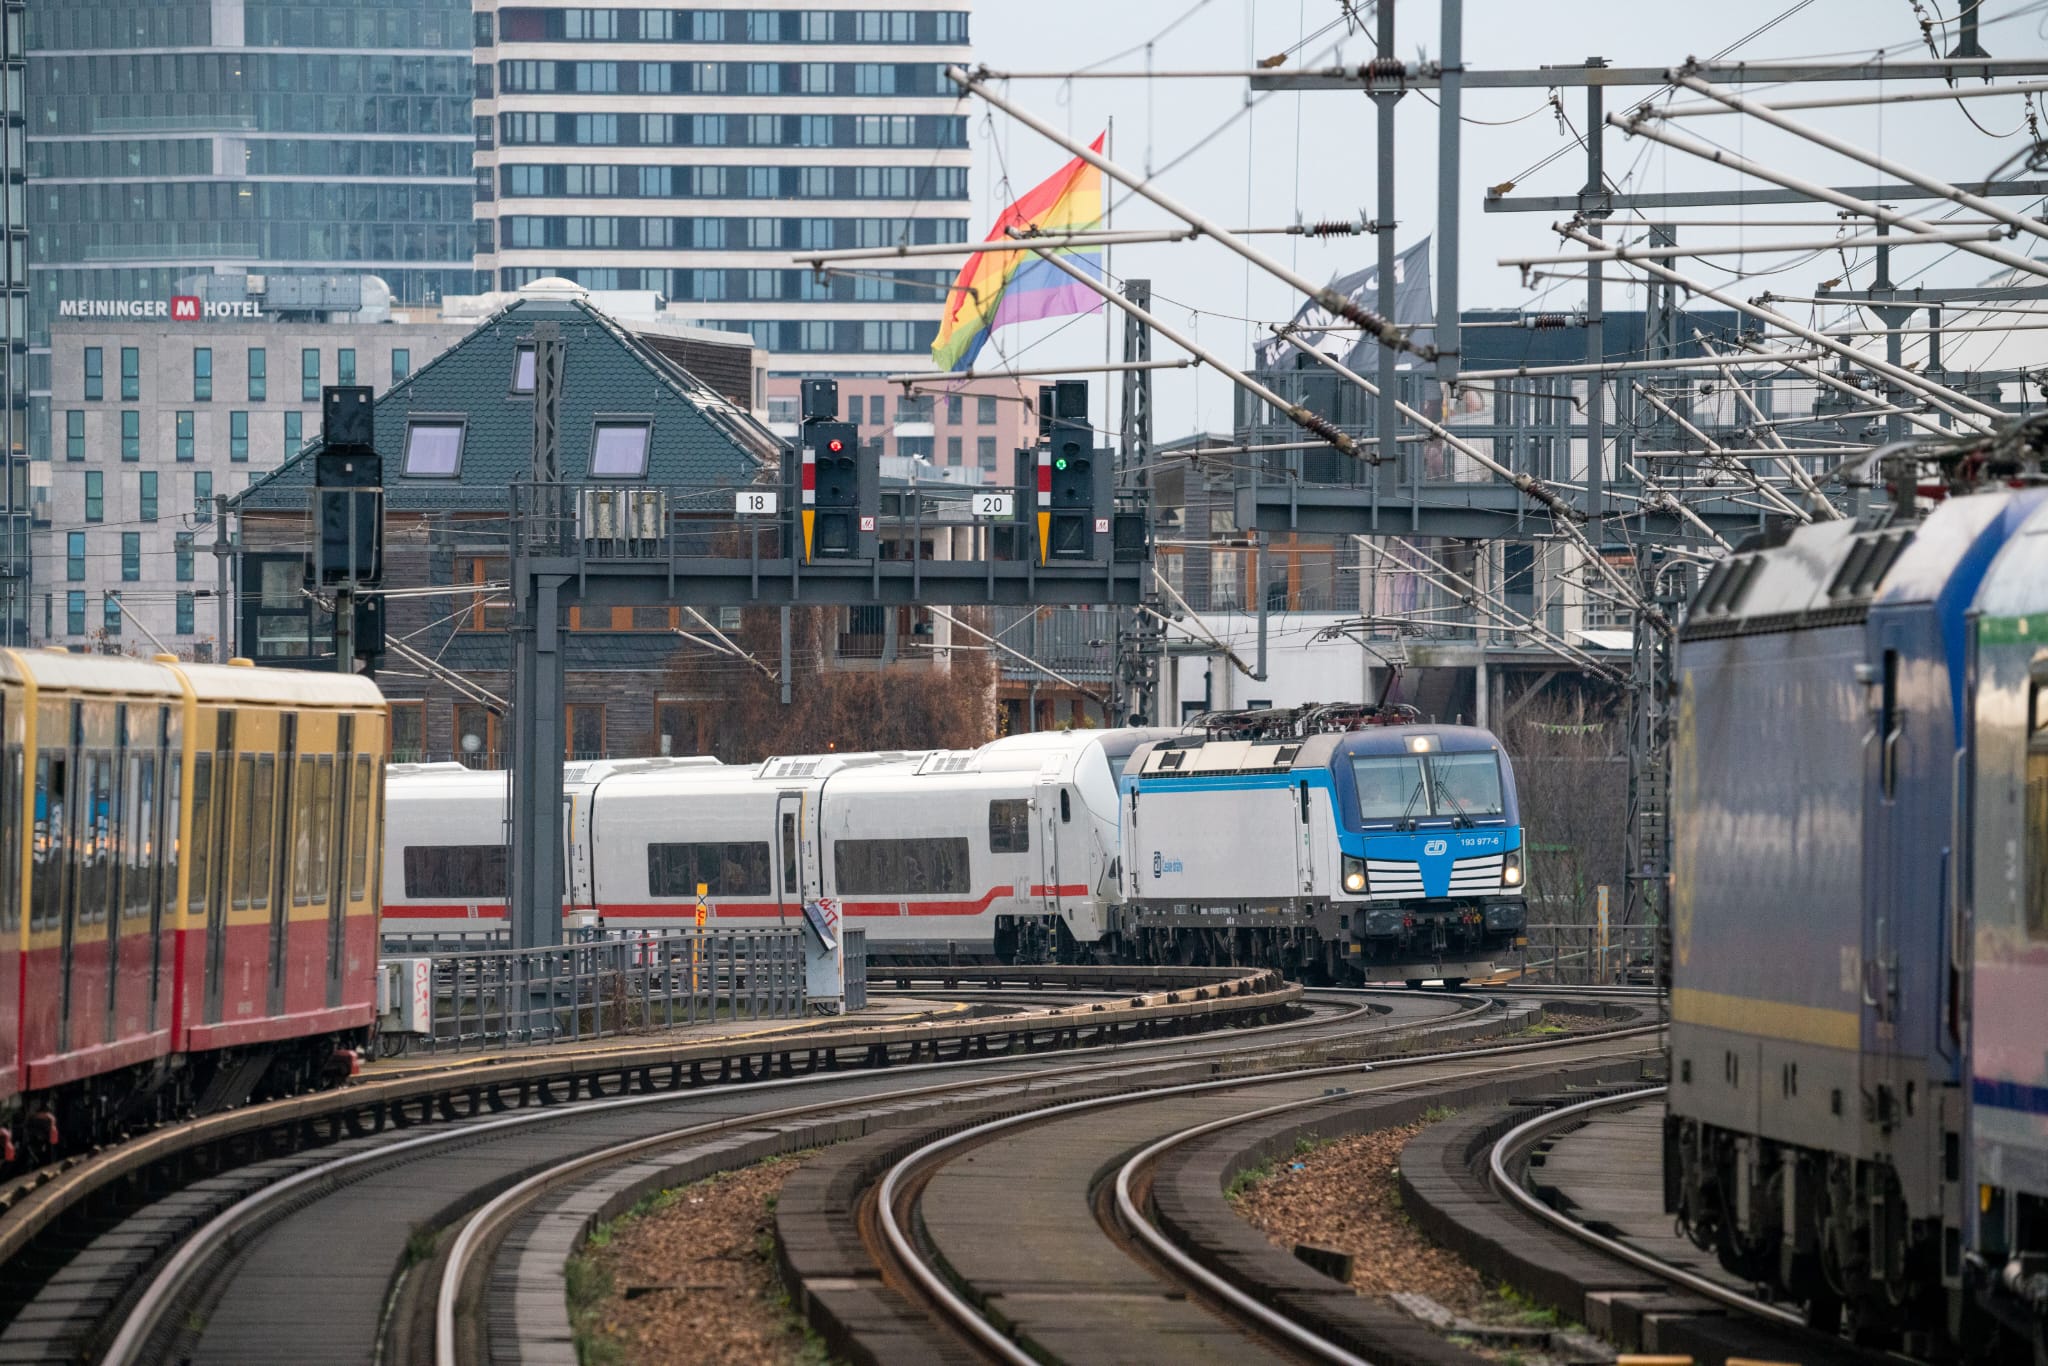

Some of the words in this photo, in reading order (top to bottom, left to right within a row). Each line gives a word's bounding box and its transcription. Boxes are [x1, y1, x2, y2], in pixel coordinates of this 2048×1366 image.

[60, 300, 168, 316] MEININGER
[176, 300, 195, 316] M
[204, 301, 263, 317] HOTEL
[749, 495, 764, 510] 18
[983, 497, 1002, 512] 20
[1461, 838, 1475, 846] 193
[1477, 837, 1499, 846] 977-6
